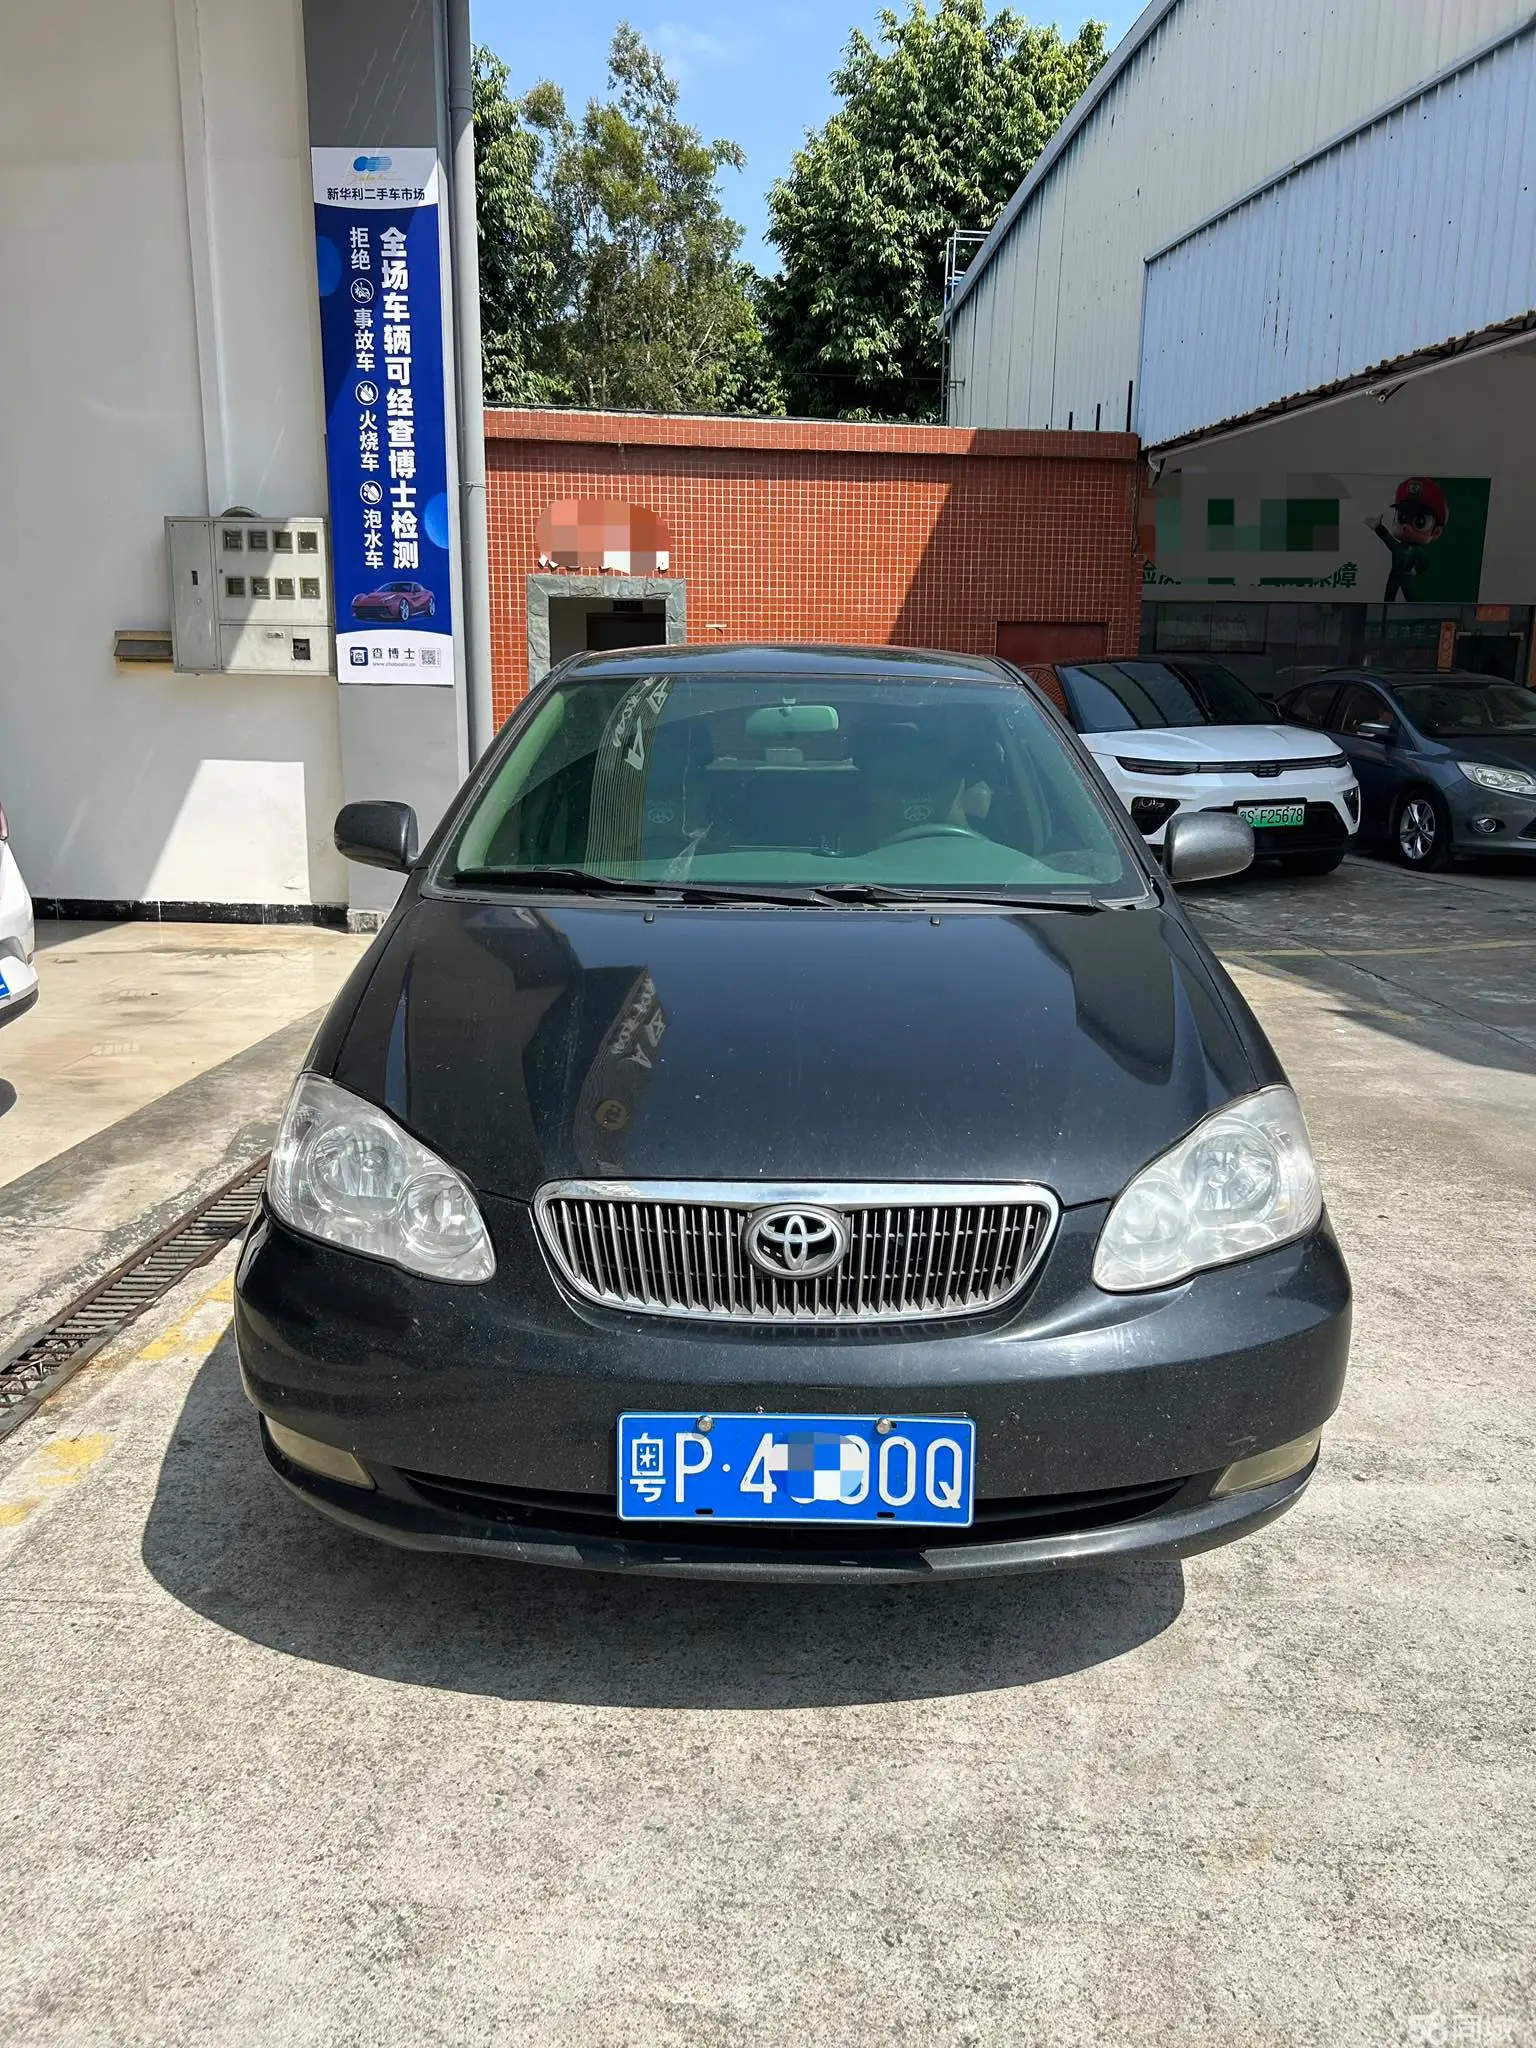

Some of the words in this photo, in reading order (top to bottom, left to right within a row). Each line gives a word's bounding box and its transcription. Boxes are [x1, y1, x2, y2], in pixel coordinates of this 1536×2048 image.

[327, 187, 425, 201] 新华利二手车市场
[349, 227, 371, 271] 拒绝
[353, 308, 375, 372] 事故车
[379, 226, 419, 570] 全场车辆可经查博士检测
[359, 409, 380, 472] 火烧车
[363, 509, 384, 570] 泡水车
